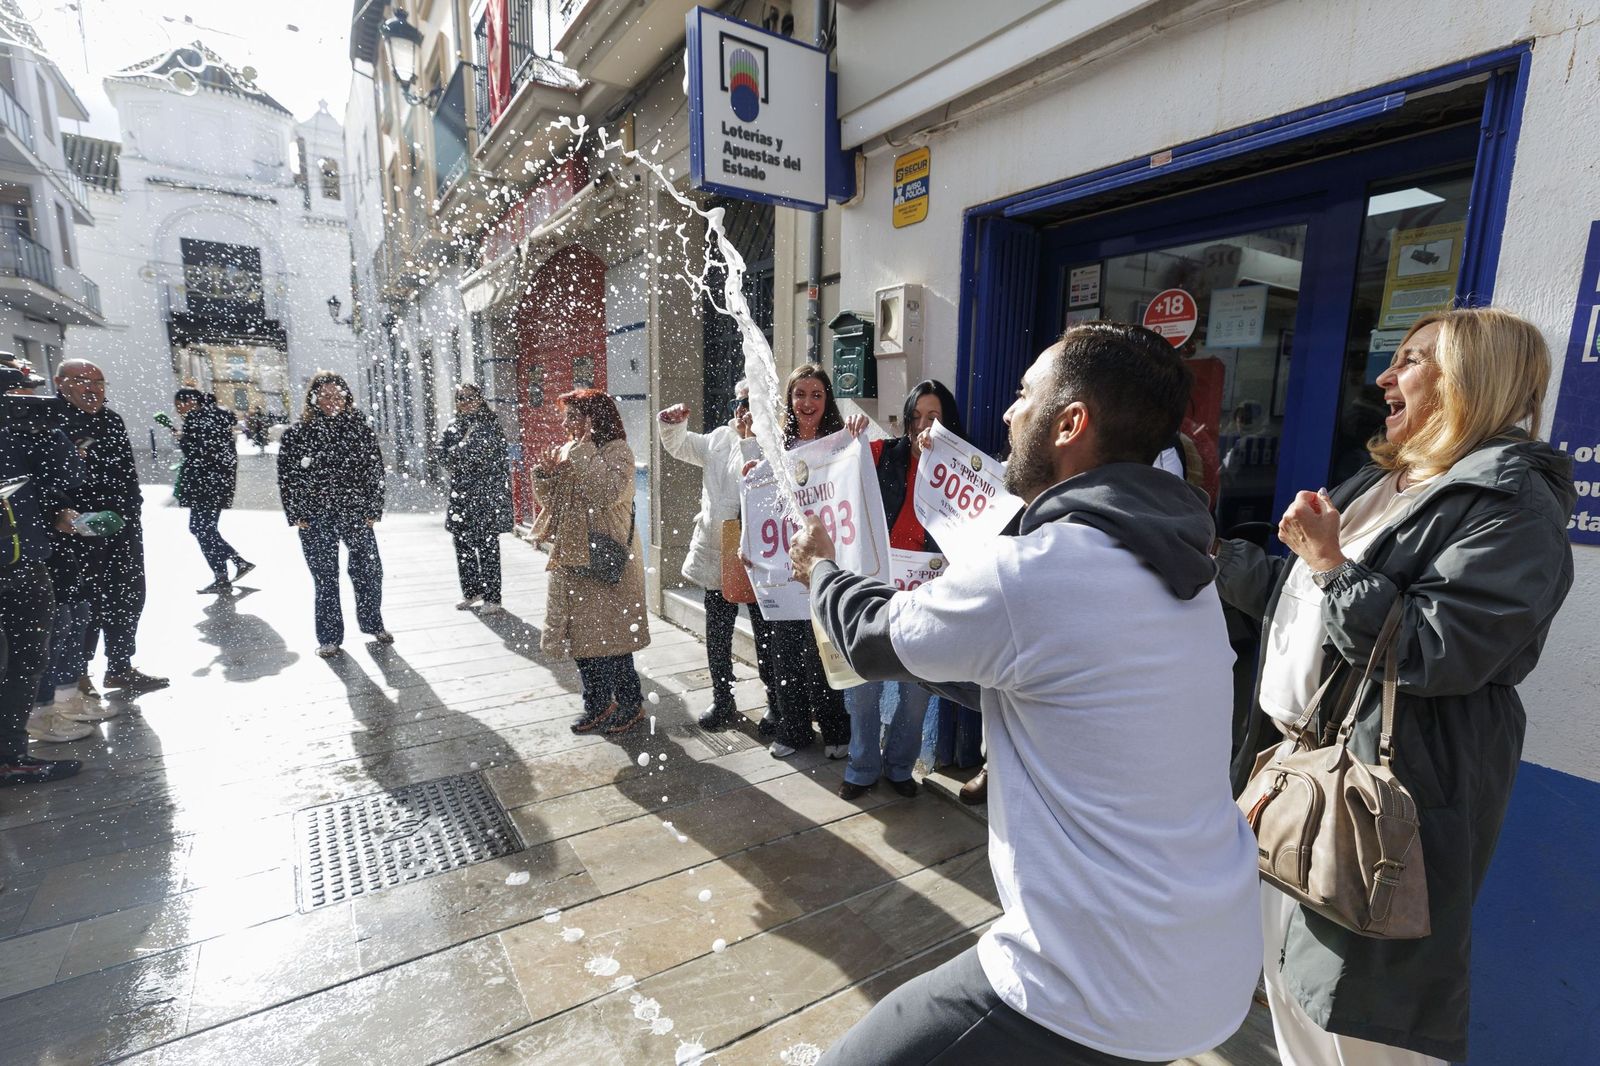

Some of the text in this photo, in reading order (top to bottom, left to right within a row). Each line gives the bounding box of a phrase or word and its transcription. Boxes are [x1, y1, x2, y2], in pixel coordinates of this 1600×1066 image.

[722, 120, 783, 153] Loterías y
[722, 159, 766, 180] Estado
[723, 140, 801, 171] Apuestas del
[1155, 295, 1184, 316] +18
[929, 463, 995, 519] 9069
[960, 464, 996, 498] PREMIO
[761, 500, 856, 558] 9093
